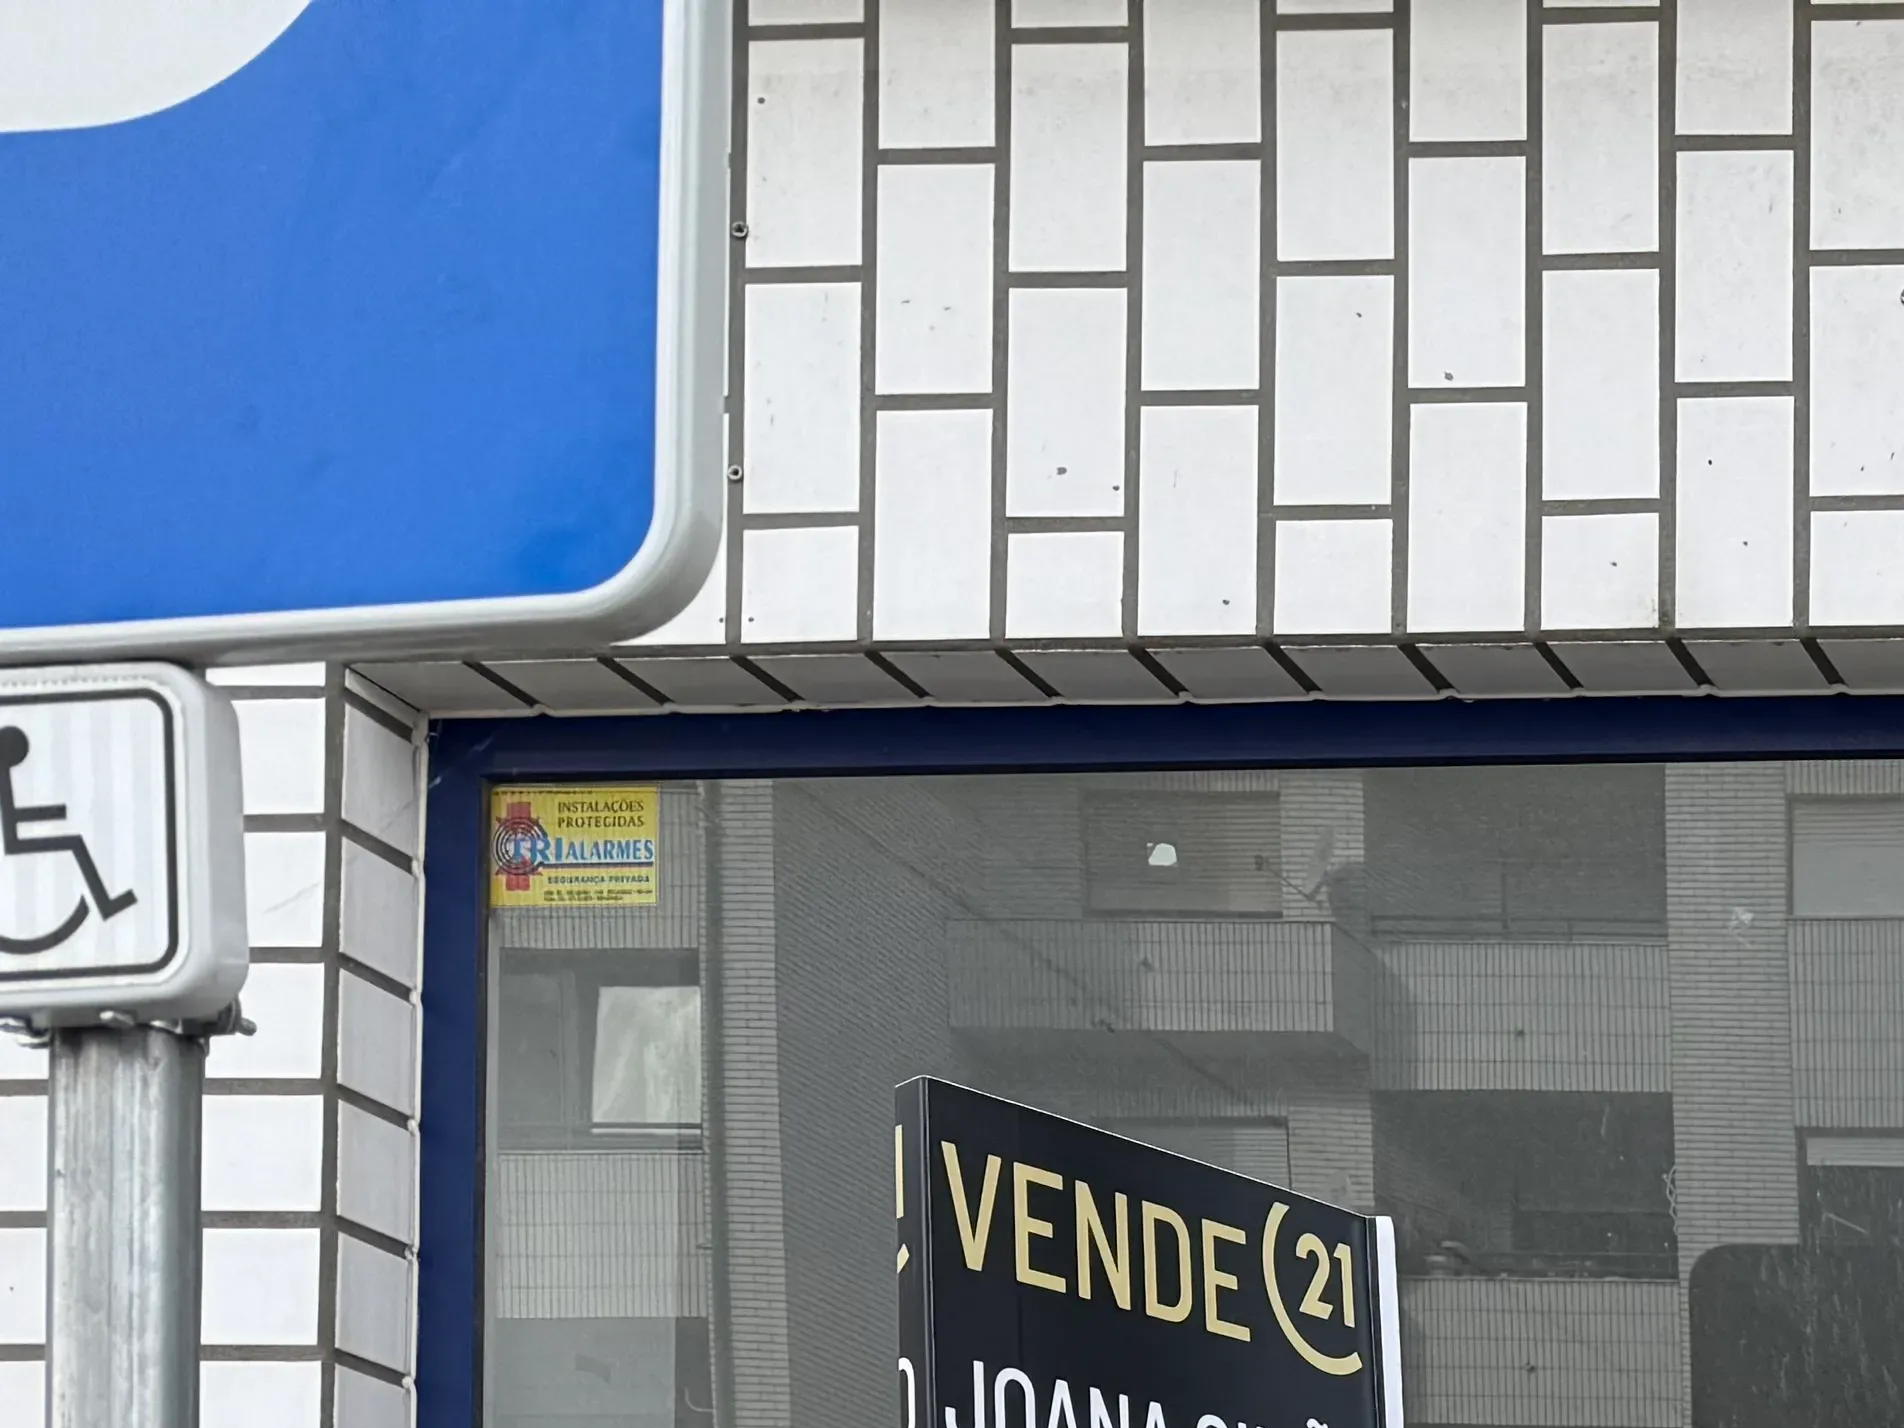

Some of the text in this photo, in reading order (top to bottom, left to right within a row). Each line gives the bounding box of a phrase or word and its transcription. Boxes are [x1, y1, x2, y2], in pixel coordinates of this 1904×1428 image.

[558, 799, 644, 815] INSTALAÇÕES
[558, 815, 644, 828] PROTEGIDAS
[941, 1140, 1251, 1342] VENDE
